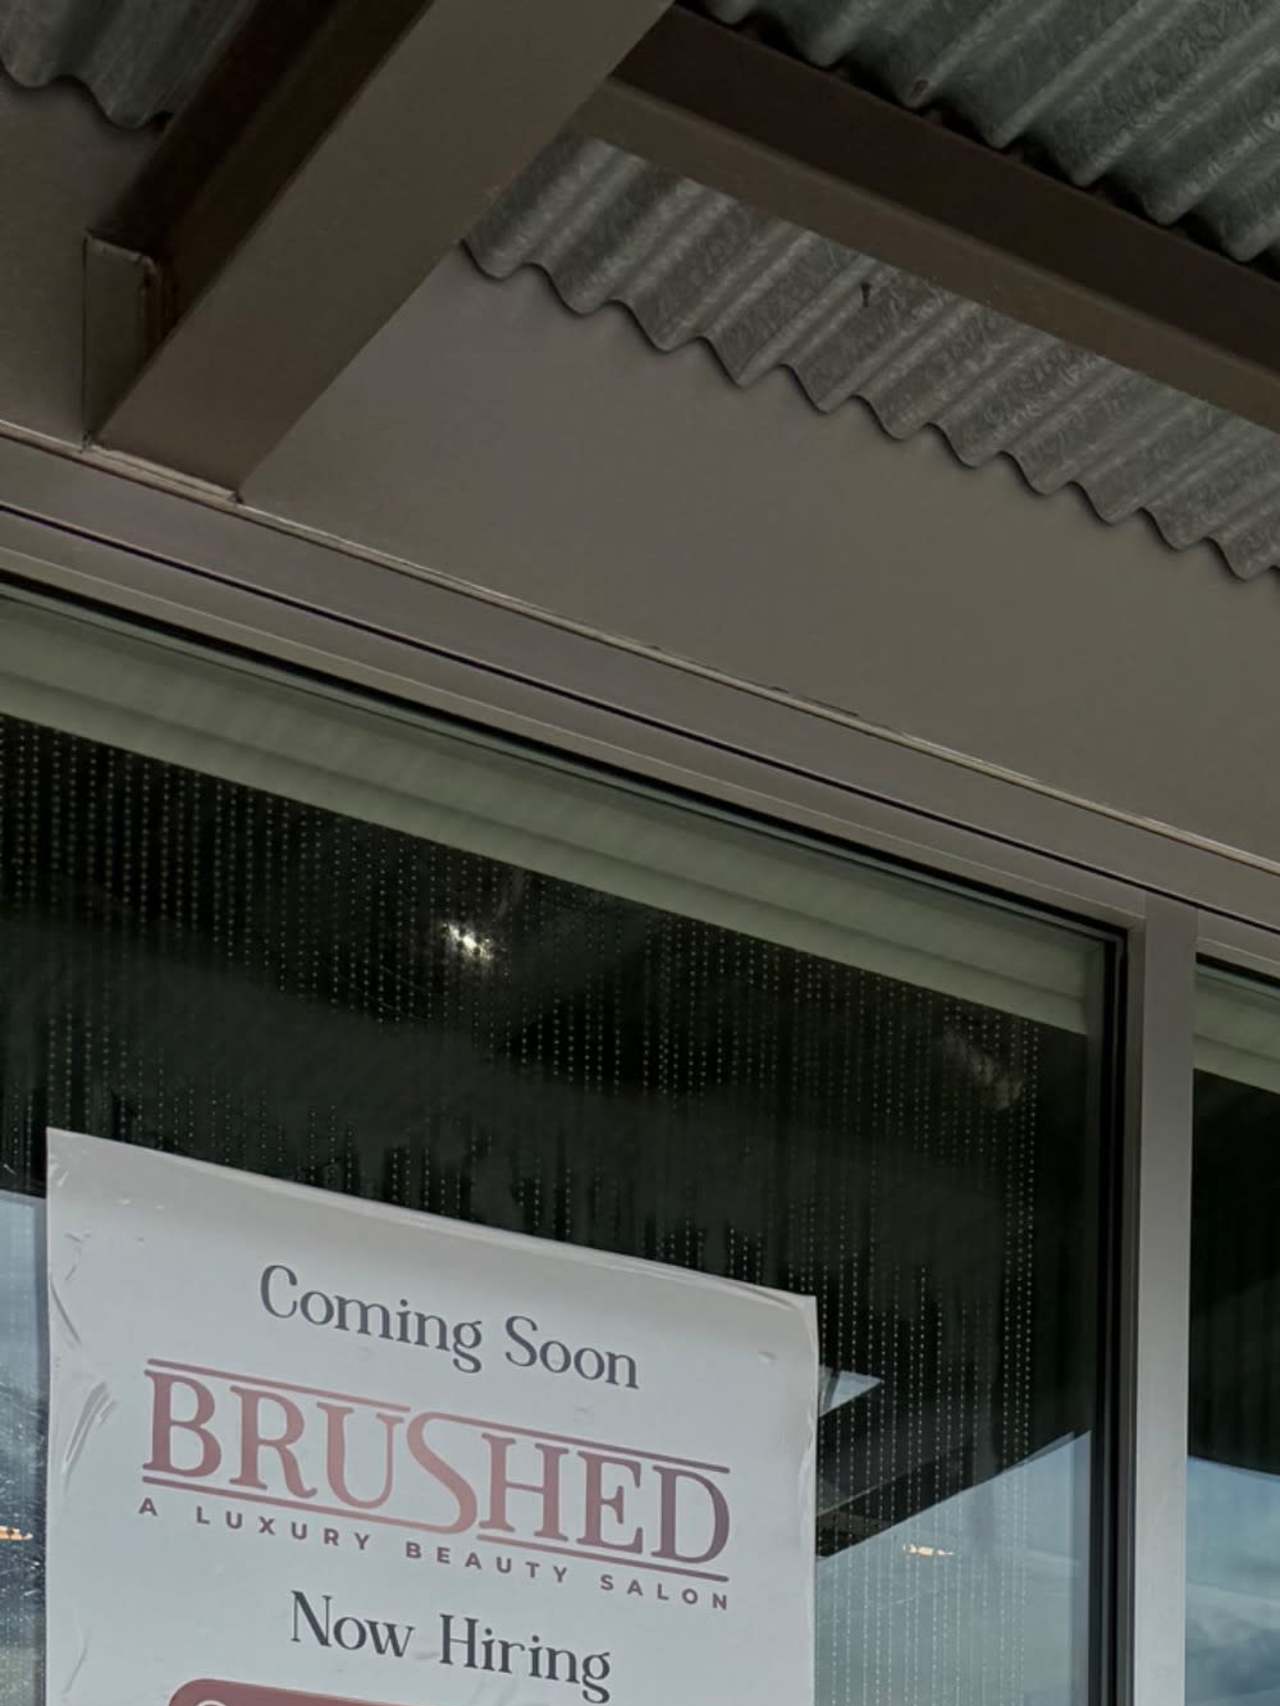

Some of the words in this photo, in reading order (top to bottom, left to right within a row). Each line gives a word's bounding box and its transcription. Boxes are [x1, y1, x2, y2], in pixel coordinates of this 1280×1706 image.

[260, 1265, 481, 1374] Coming
[505, 1314, 639, 1390] Soon
[143, 1368, 731, 1566] BRUSHED
[138, 1498, 158, 1517] A
[196, 1505, 371, 1551] LUXURY
[406, 1542, 569, 1583] BEAUTY
[601, 1574, 729, 1610] SALON
[291, 1591, 414, 1657] Now
[439, 1614, 611, 1704] Hiring
